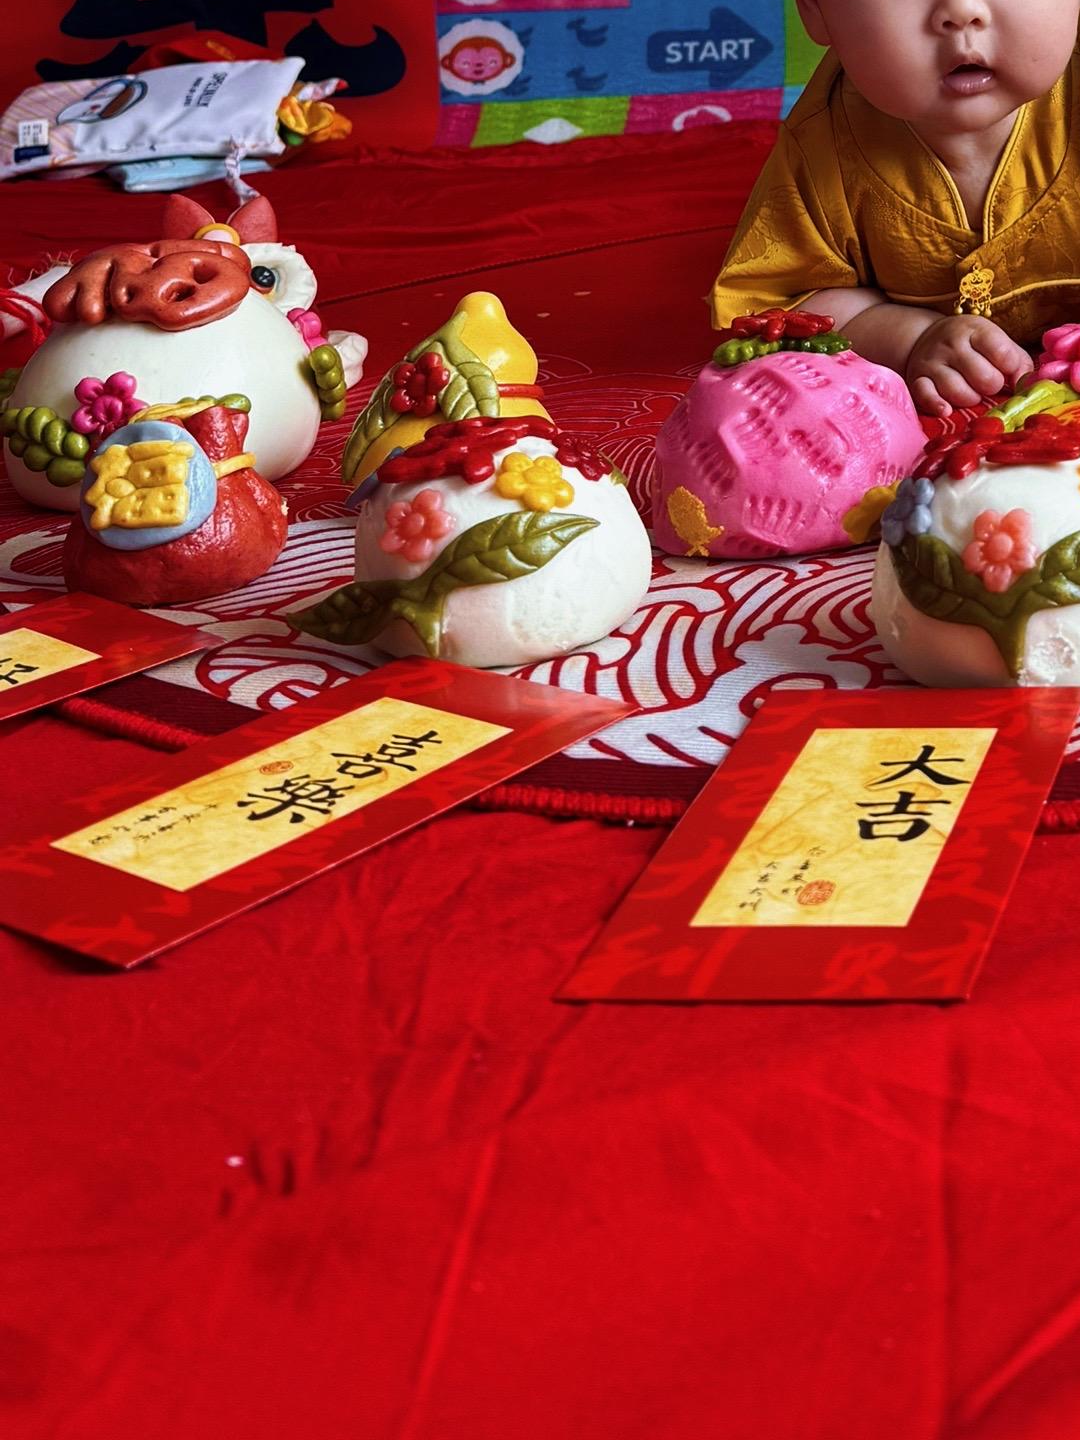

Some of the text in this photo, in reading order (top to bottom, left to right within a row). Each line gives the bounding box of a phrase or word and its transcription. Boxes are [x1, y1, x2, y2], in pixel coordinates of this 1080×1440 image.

[664, 38, 756, 64] START
[236, 729, 443, 824] 喜樂
[855, 744, 972, 842] 大吉
